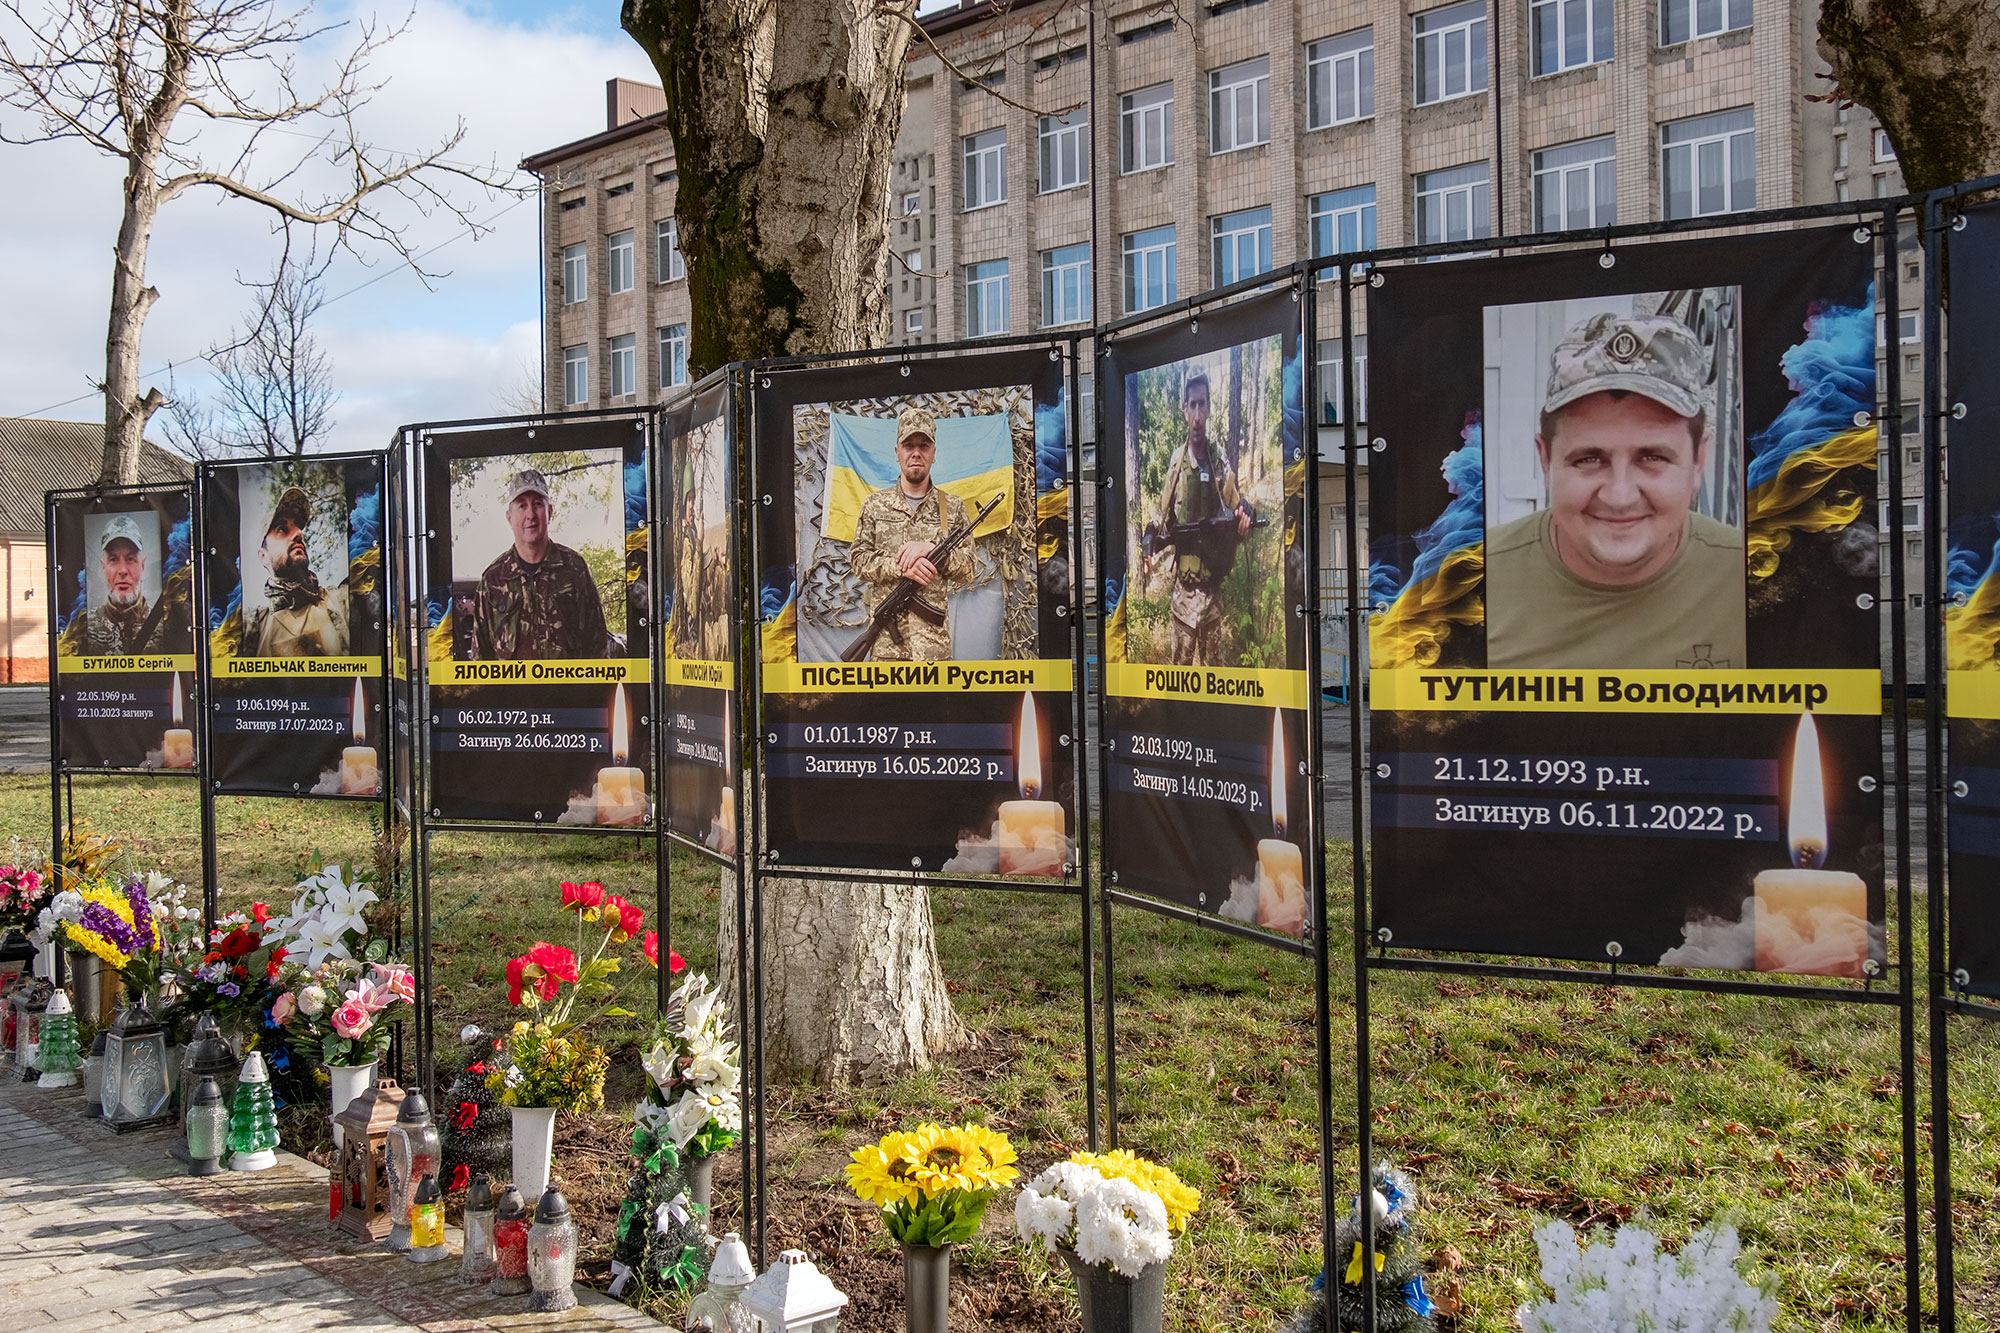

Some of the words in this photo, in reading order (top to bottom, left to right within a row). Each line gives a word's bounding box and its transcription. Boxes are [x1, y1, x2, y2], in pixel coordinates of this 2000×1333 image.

[83, 658, 135, 669] БУТИЛОВ
[138, 657, 173, 670] Сергій
[229, 661, 305, 672] ПАВЕЛЬЧАК
[309, 661, 367, 672] Валентин
[454, 660, 527, 678] ЯЛОВИЙ
[532, 664, 626, 680] Олександр
[708, 666, 723, 686] Юрій
[802, 663, 939, 689] ПІСЕЦЬКИЙ
[948, 665, 1035, 690] Руслан
[1146, 670, 1201, 693] РОШКО
[1207, 673, 1265, 697] Василь
[77, 691, 120, 701] 22.05.1969
[122, 694, 136, 702] р.н.
[1420, 677, 1583, 702] ТУТИНІН
[1598, 677, 1827, 711] Володимир
[78, 708, 120, 717] 22.10.2023
[122, 710, 153, 719] загинув
[237, 699, 289, 710] 19.06.1994
[292, 702, 309, 713] р.н.
[236, 719, 276, 732] Загинув
[280, 719, 333, 730] 17.07.2023
[336, 722, 344, 733] р.
[459, 711, 527, 724] 06.02.1972
[531, 714, 554, 727] р.н.
[459, 734, 511, 750] Загинув
[515, 734, 586, 748] 26.06.2023
[590, 738, 602, 751] р.
[805, 727, 898, 744] 01.01.1987
[904, 731, 936, 748] р.н.
[677, 738, 694, 759] Загинув
[1132, 736, 1192, 760] 23.03.1992
[1196, 748, 1216, 766] р.н.
[806, 756, 876, 777] Загинув
[883, 757, 980, 775] 16.05.2023
[987, 763, 1003, 780] р.
[1435, 758, 1586, 784] 21.12.1993
[1596, 767, 1649, 790] р.н.
[1134, 769, 1178, 796] Загинув
[1182, 776, 1246, 804] 14.05.2023
[1250, 791, 1262, 811] р.
[1436, 799, 1550, 830] Загинув
[1560, 802, 1724, 830] 06.11.2022
[1735, 814, 1761, 838] р.
